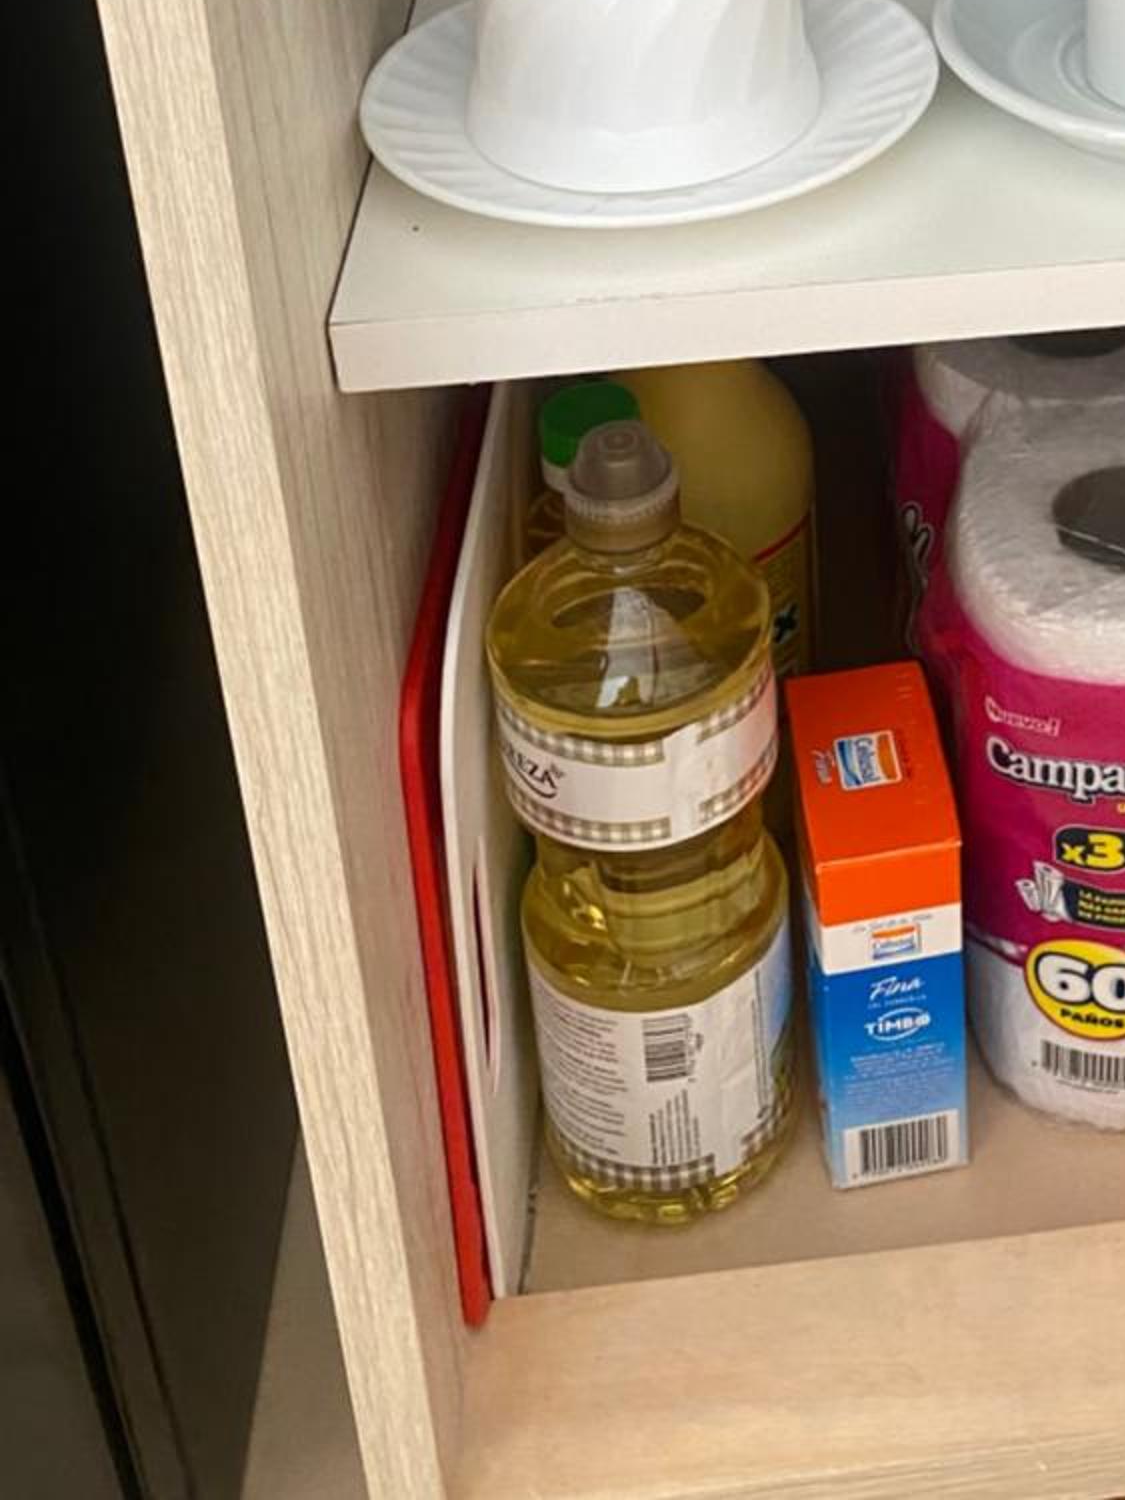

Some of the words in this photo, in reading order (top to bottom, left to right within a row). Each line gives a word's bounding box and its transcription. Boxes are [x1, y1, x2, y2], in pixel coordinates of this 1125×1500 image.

[1061, 833, 1125, 869] x3
[869, 976, 926, 1001] Fina
[1060, 1007, 1125, 1029] PAÑOS
